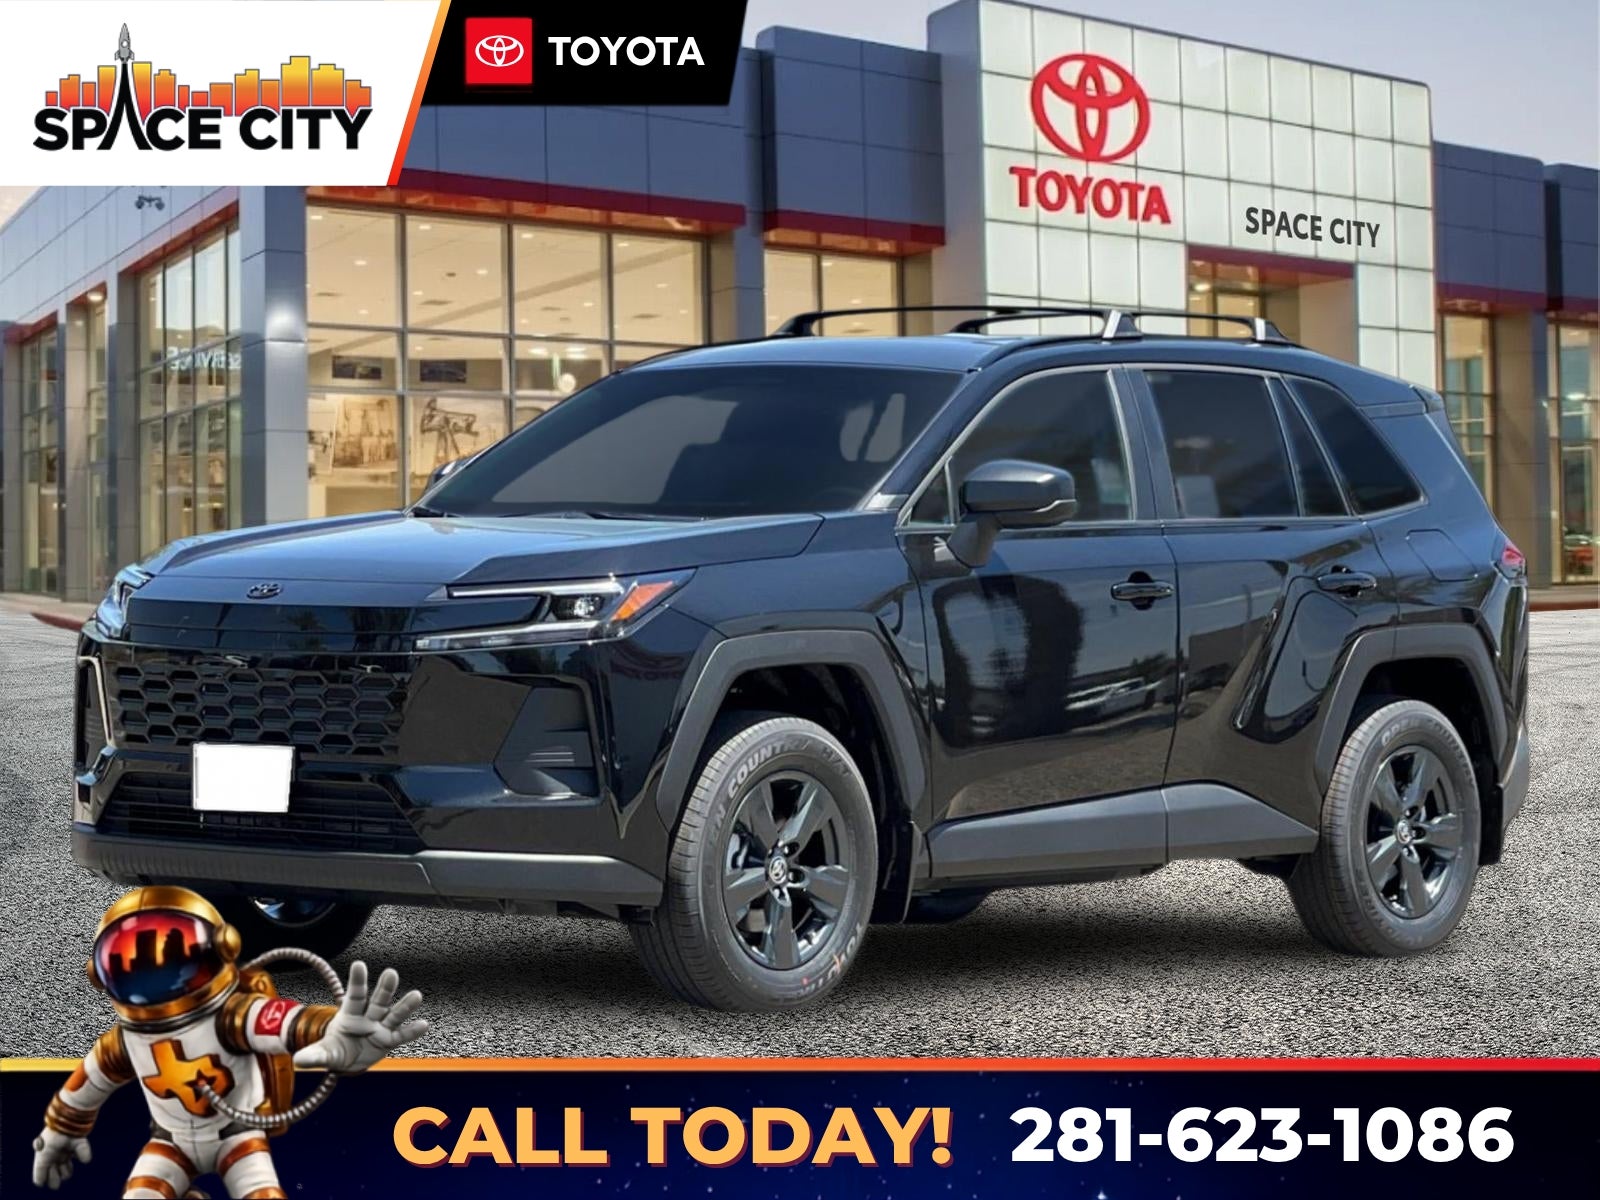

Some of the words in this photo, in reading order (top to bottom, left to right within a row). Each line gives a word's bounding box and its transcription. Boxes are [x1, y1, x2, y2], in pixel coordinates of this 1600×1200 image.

[1008, 165, 1171, 225] TOYOTA
[1244, 206, 1323, 243] SPACE
[1329, 217, 1381, 249] CITY
